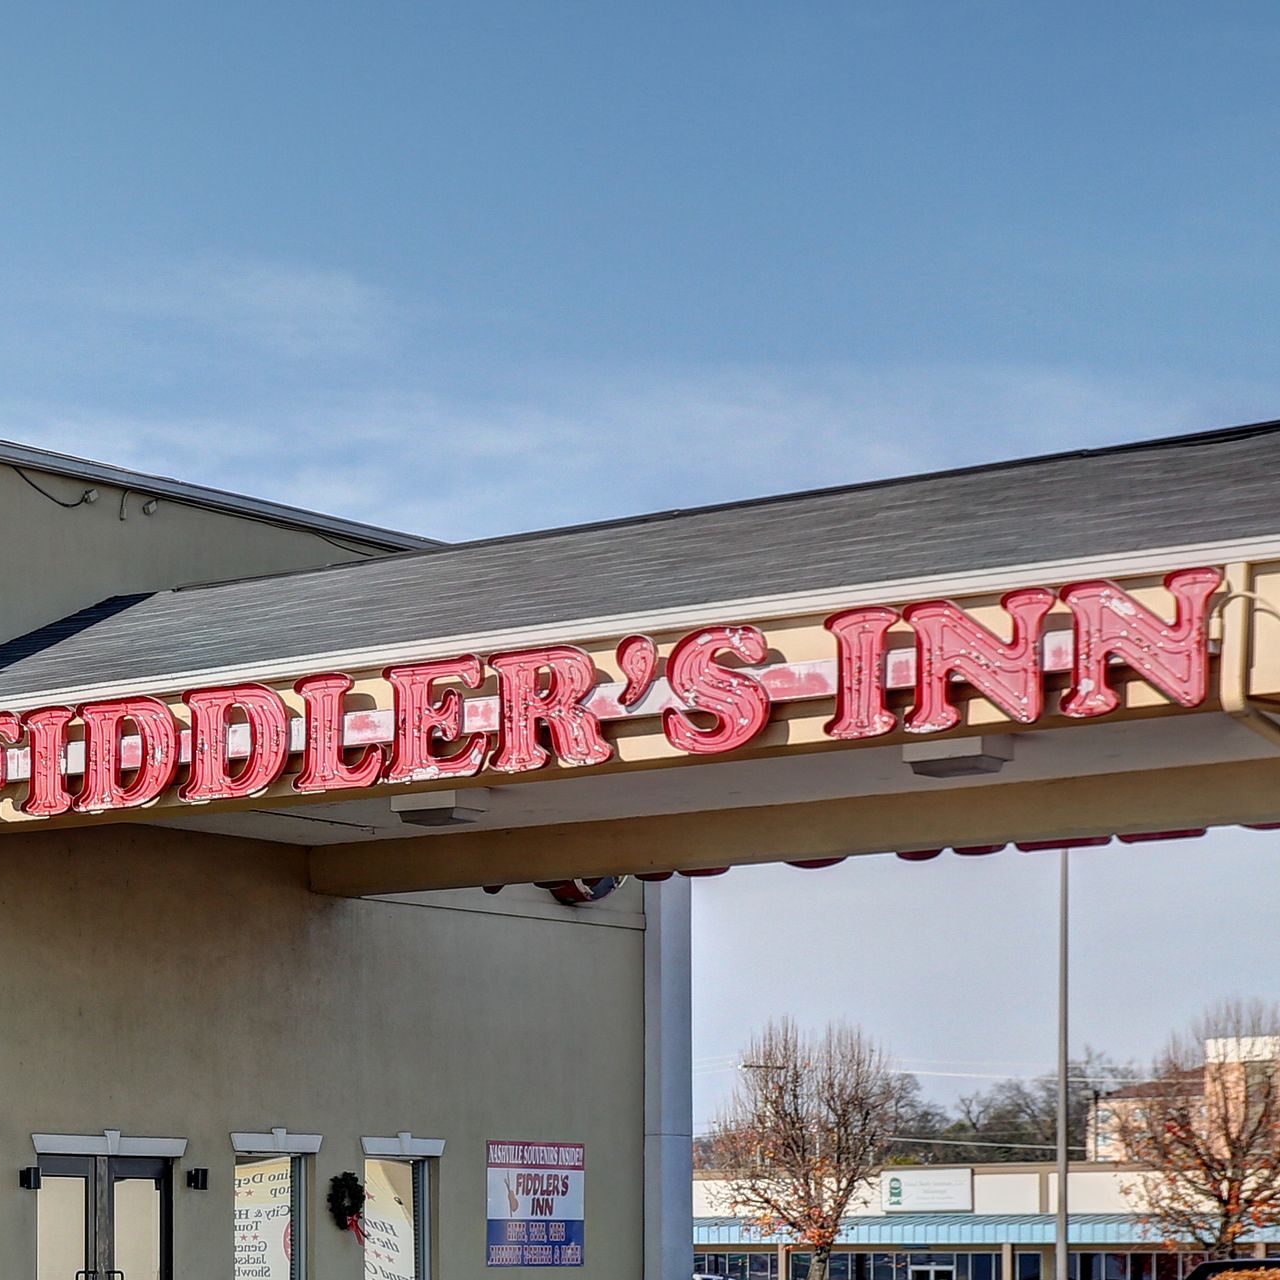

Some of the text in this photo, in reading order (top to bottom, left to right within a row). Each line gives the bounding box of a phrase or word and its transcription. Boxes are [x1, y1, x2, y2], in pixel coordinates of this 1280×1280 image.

[823, 567, 1223, 740] INN
[488, 1144, 522, 1165] NASHVILLE
[523, 1145, 558, 1167] SOUVENIRS
[515, 1173, 570, 1197] FIDDLER'S
[531, 1197, 554, 1217] INN
